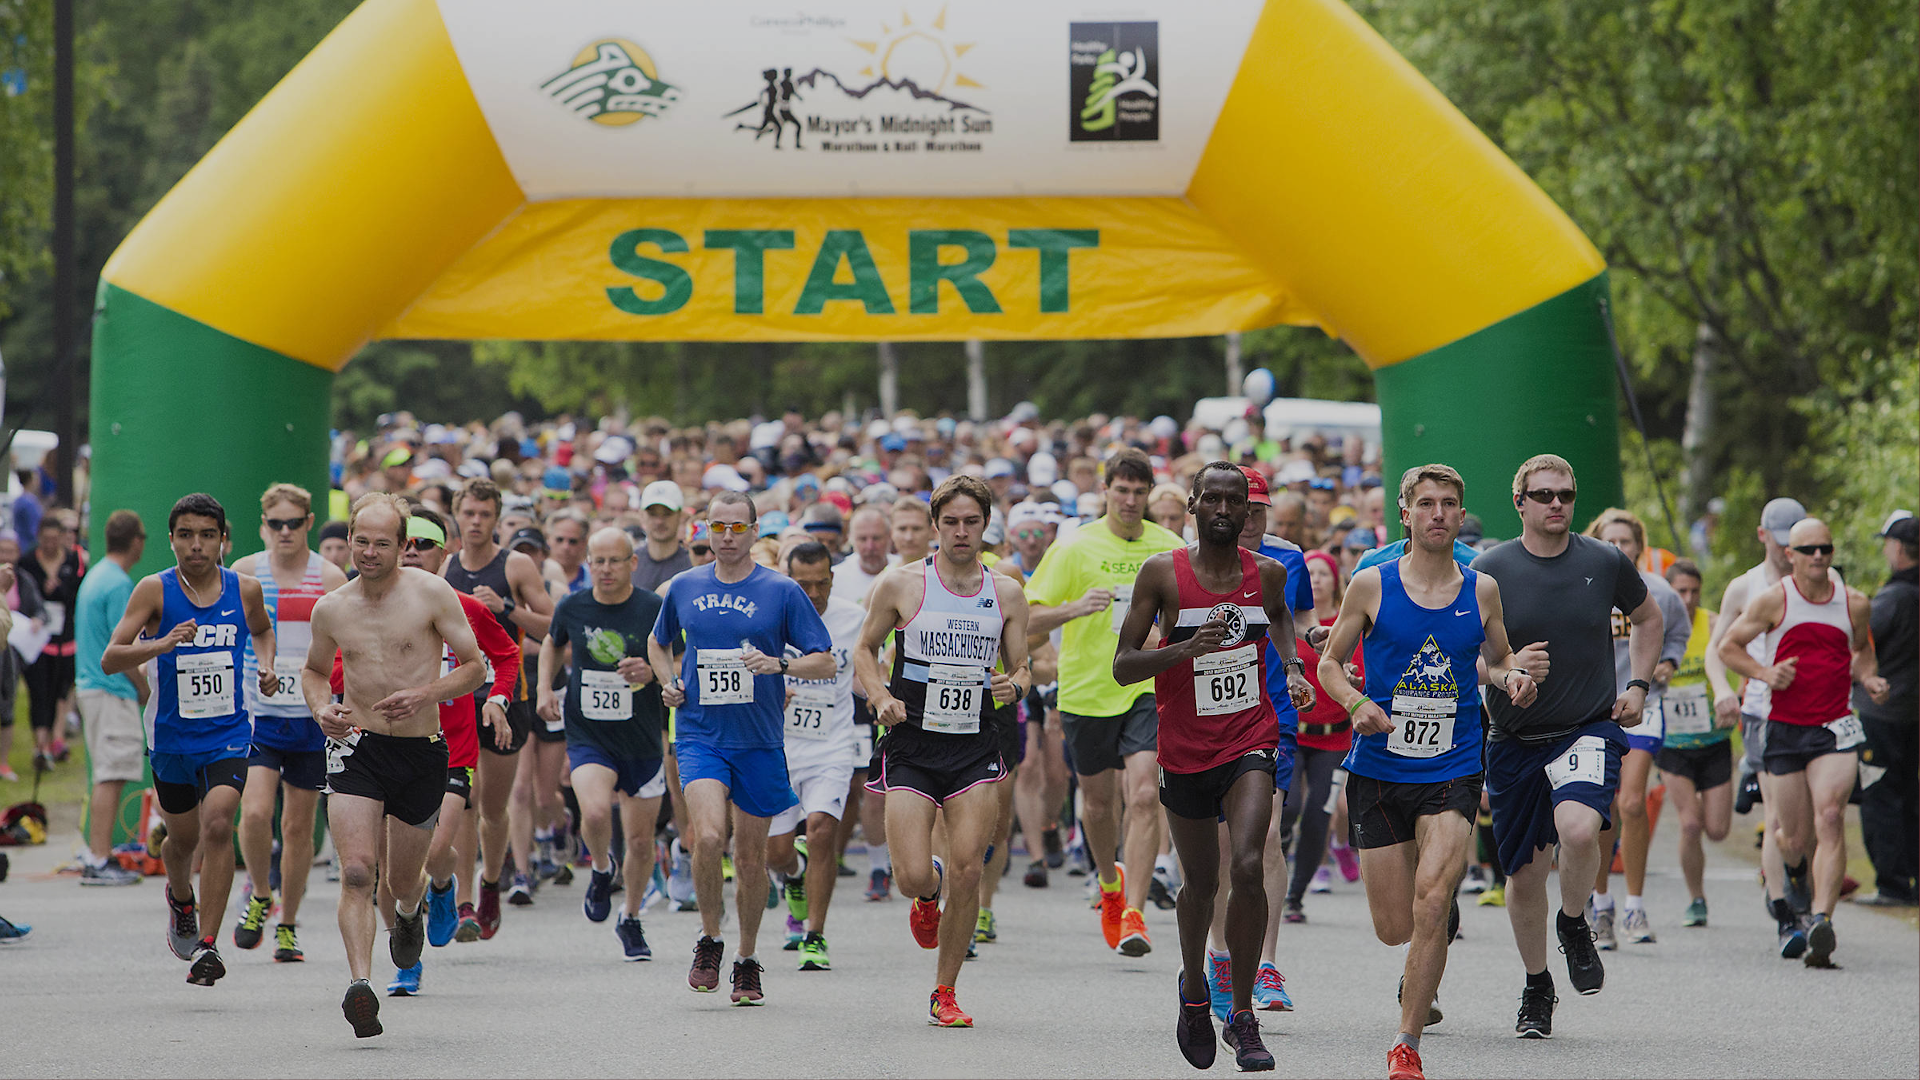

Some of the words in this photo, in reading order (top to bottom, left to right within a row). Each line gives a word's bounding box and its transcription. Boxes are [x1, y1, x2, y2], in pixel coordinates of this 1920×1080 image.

[808, 115, 873, 137] Mayor's
[880, 115, 954, 136] Midnight
[961, 116, 993, 133] Sun
[605, 227, 1099, 316] START
[692, 593, 758, 618] TRACK
[176, 624, 238, 648] CR
[946, 618, 980, 632] WESTERN
[191, 674, 222, 696] 550
[709, 670, 741, 693] 558
[1211, 673, 1247, 702] 692
[1398, 681, 1456, 692] ALASKA
[593, 690, 620, 710] 528
[940, 687, 972, 711] 638
[793, 707, 822, 729] 573
[1403, 720, 1441, 746] 872
[1569, 753, 1578, 771] 9
